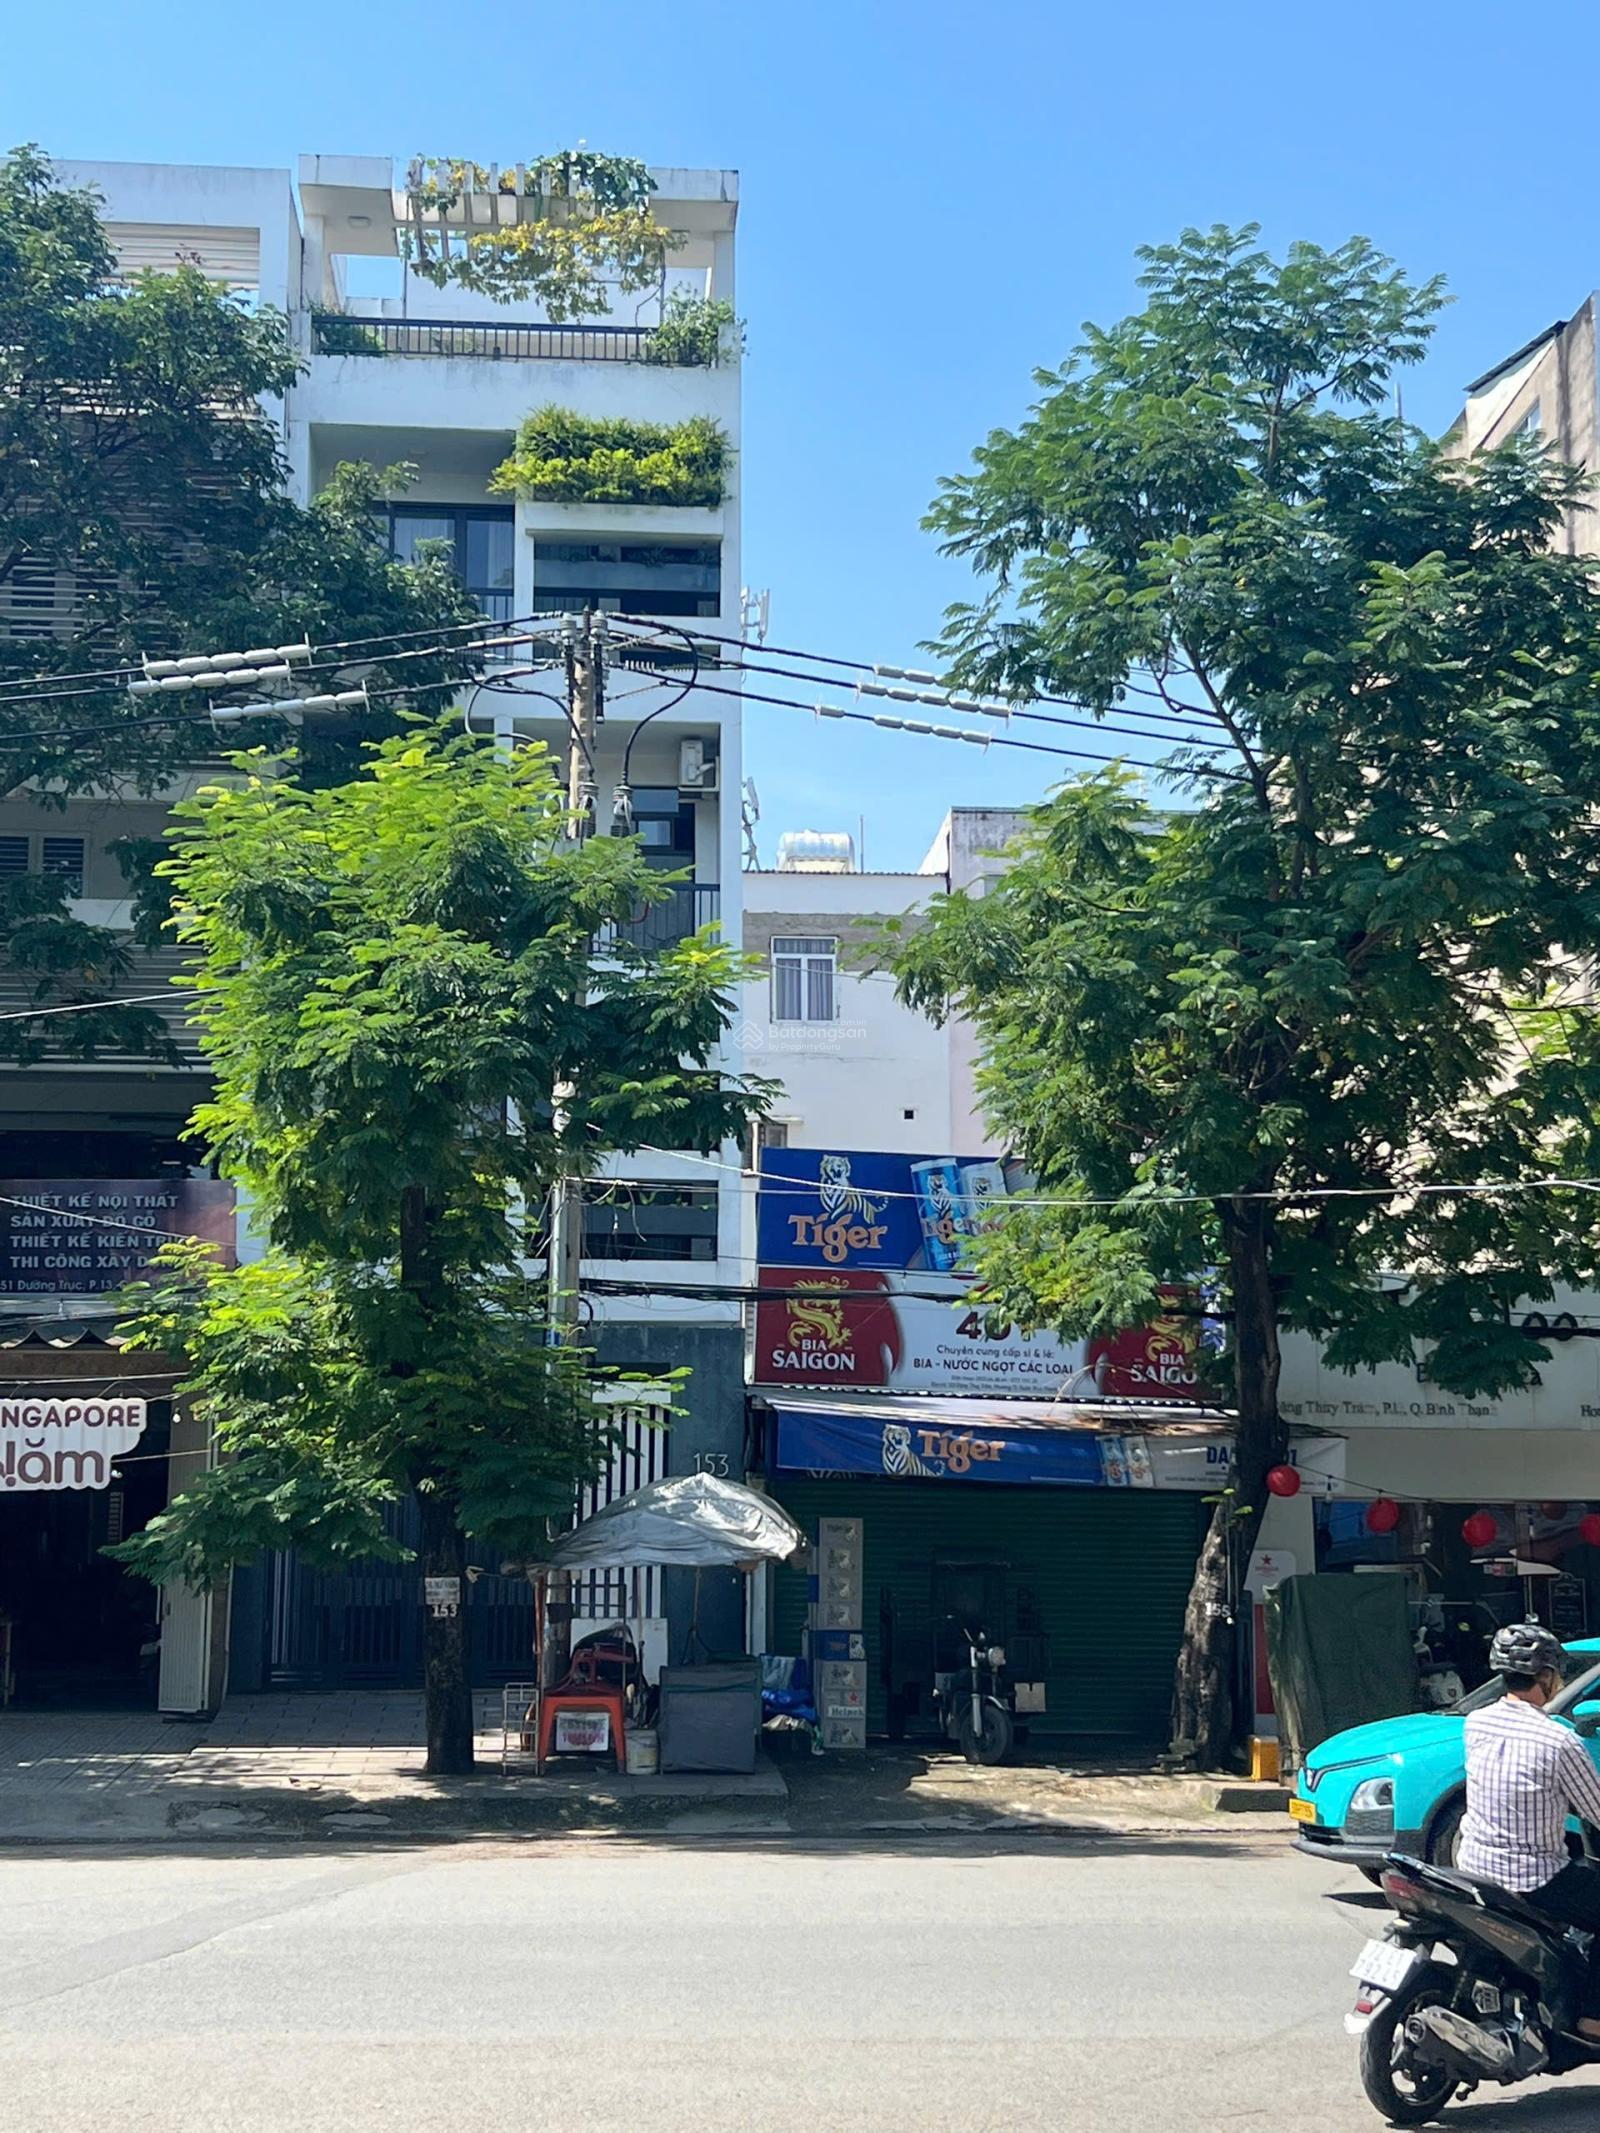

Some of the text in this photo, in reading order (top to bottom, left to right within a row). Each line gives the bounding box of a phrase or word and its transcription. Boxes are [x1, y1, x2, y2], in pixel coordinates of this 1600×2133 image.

[13, 1191, 178, 1209] THIẾT KẾ NỘI THẤT
[10, 1211, 46, 1227] SẢN
[10, 1232, 62, 1248] THIẾT
[67, 1232, 93, 1248] KẾ
[98, 1231, 139, 1248] KIẾN
[787, 1213, 888, 1262] Tiger
[10, 1256, 39, 1268] THI
[44, 1253, 92, 1268] CÔNG
[97, 1253, 131, 1268] XÂY
[801, 1339, 827, 1351] BIA
[772, 1349, 855, 1371] SAIGON
[1034, 1350, 1040, 1358] &
[1160, 1353, 1184, 1365] BIA
[913, 1358, 933, 1369] BIA
[943, 1357, 979, 1371] NƯỚC
[982, 1362, 1015, 1375] NGỌT
[1018, 1361, 1043, 1374] CÁC
[917, 1430, 1005, 1473] Tiger
[693, 1452, 729, 1477] 153
[432, 1604, 457, 1618] 153
[1205, 1602, 1231, 1618] 155
